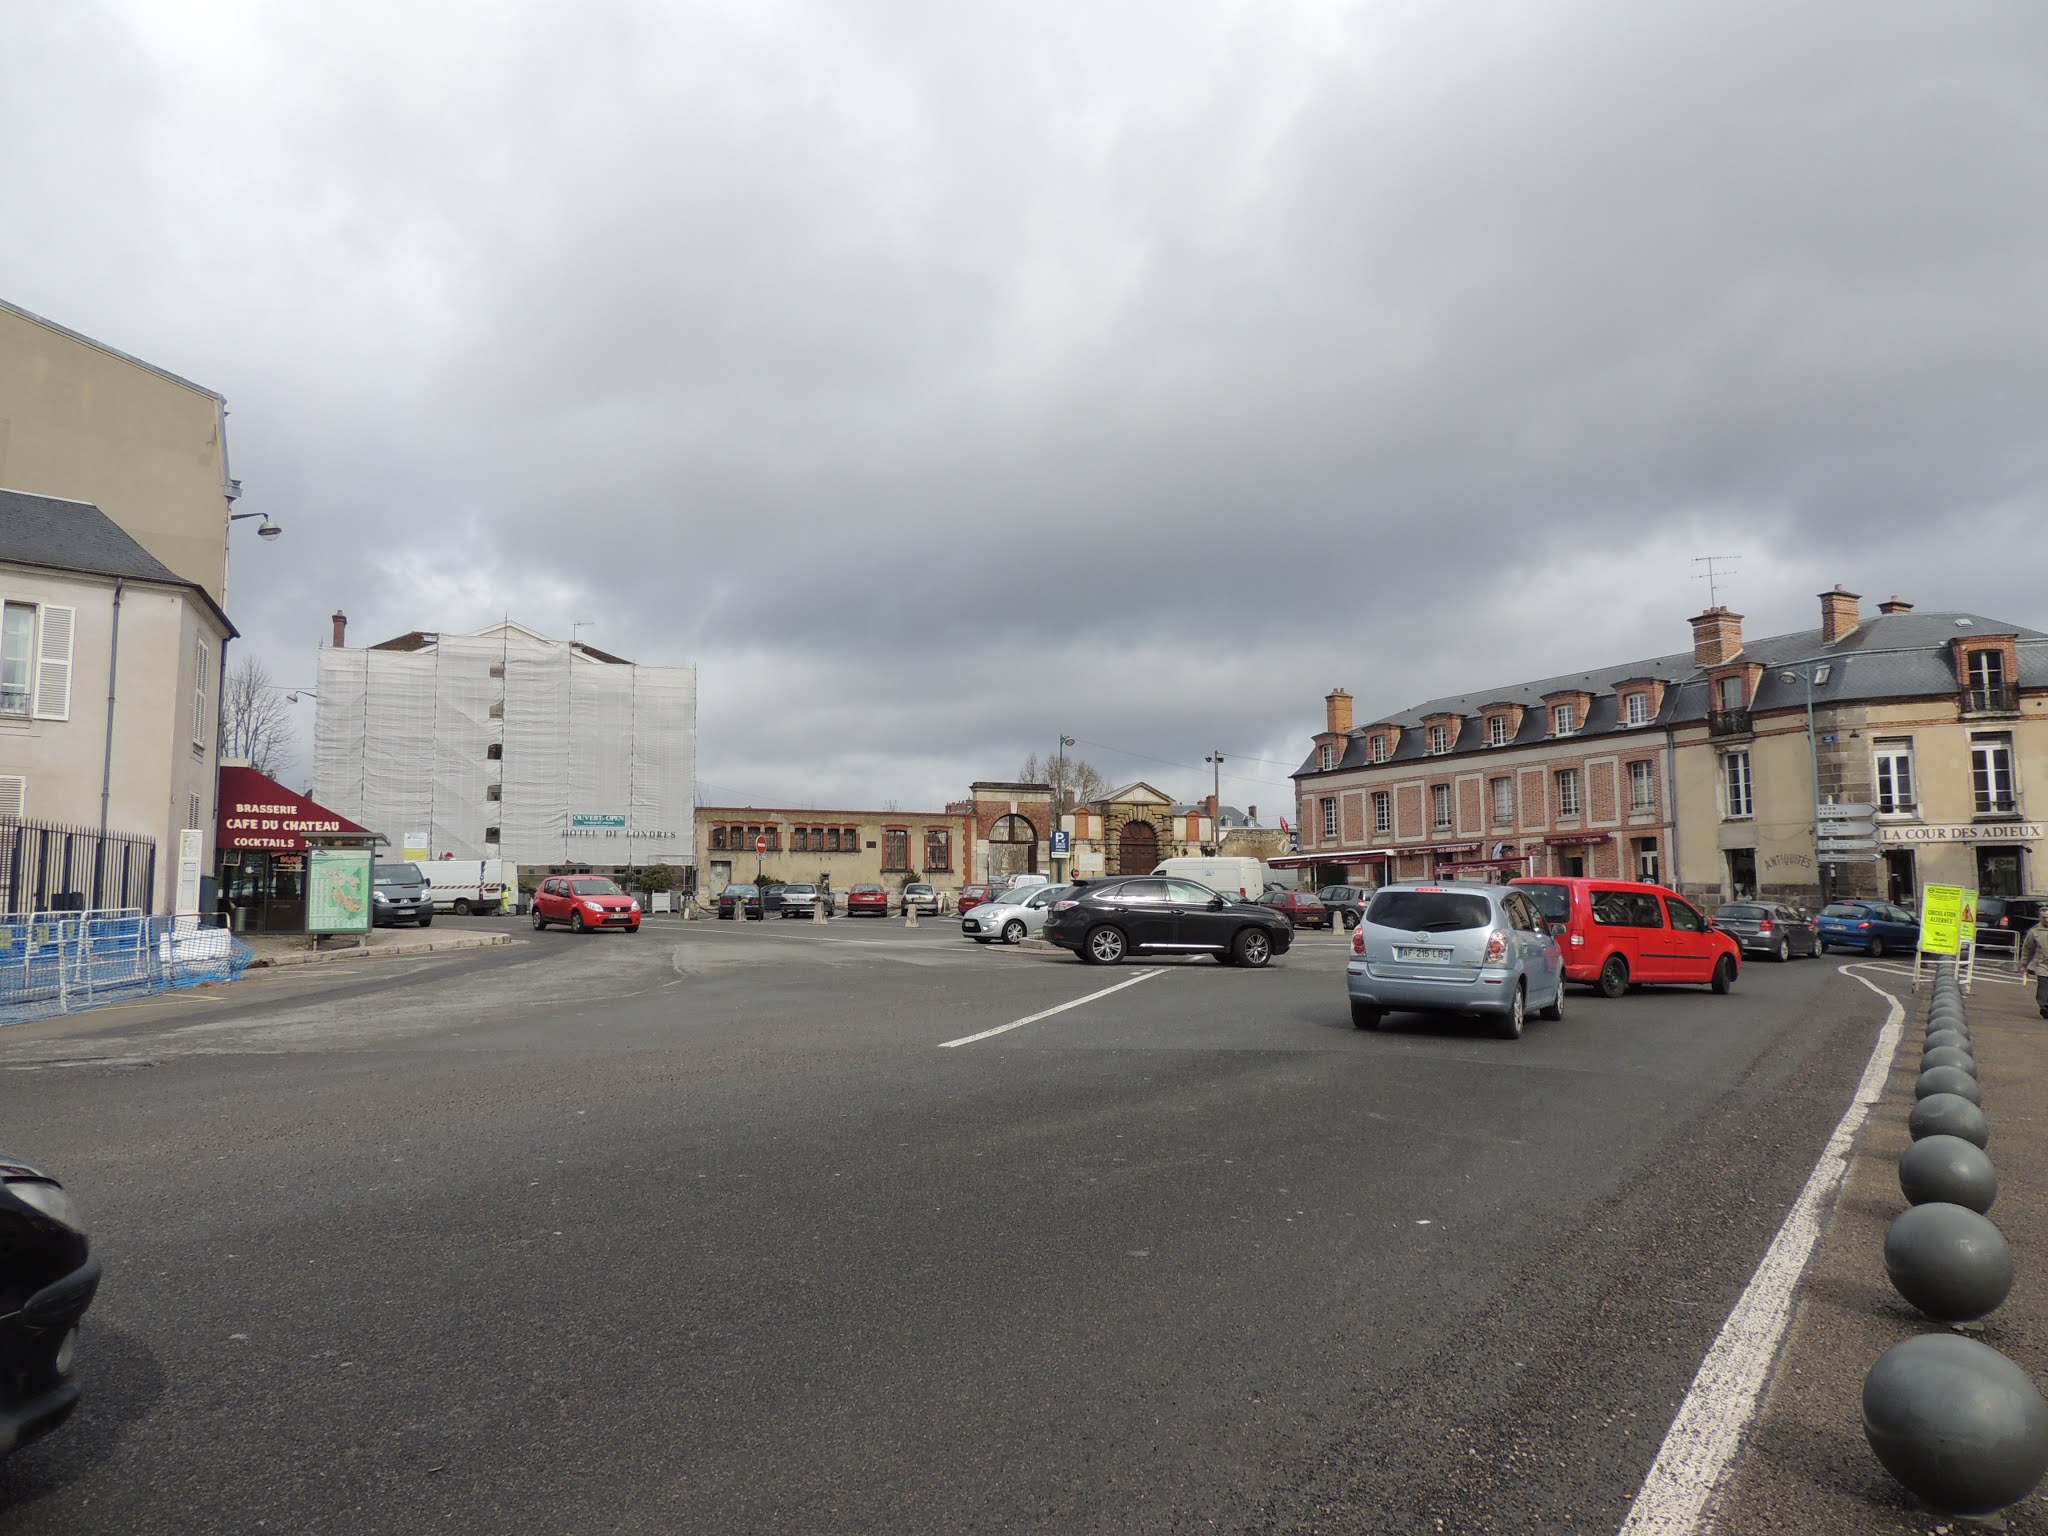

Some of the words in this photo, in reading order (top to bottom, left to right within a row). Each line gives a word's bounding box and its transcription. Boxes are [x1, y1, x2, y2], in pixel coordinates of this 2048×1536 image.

[236, 803, 298, 815] BRASSERIE
[226, 819, 258, 830] CAFE
[261, 819, 279, 831] DU
[282, 820, 340, 832] CHATEAU
[562, 829, 598, 838] HOTEL
[605, 830, 620, 838] DE
[626, 830, 676, 839] LONDRES
[1883, 830, 1901, 840] LA
[1905, 828, 1946, 840] COUR
[1951, 827, 1978, 838] DES
[1982, 825, 2041, 838] ADIEUX
[233, 837, 295, 848] COCKTAILS
[1764, 853, 1812, 870] ANTIQUITÉS
[1927, 909, 1956, 917] CIRCULATION
